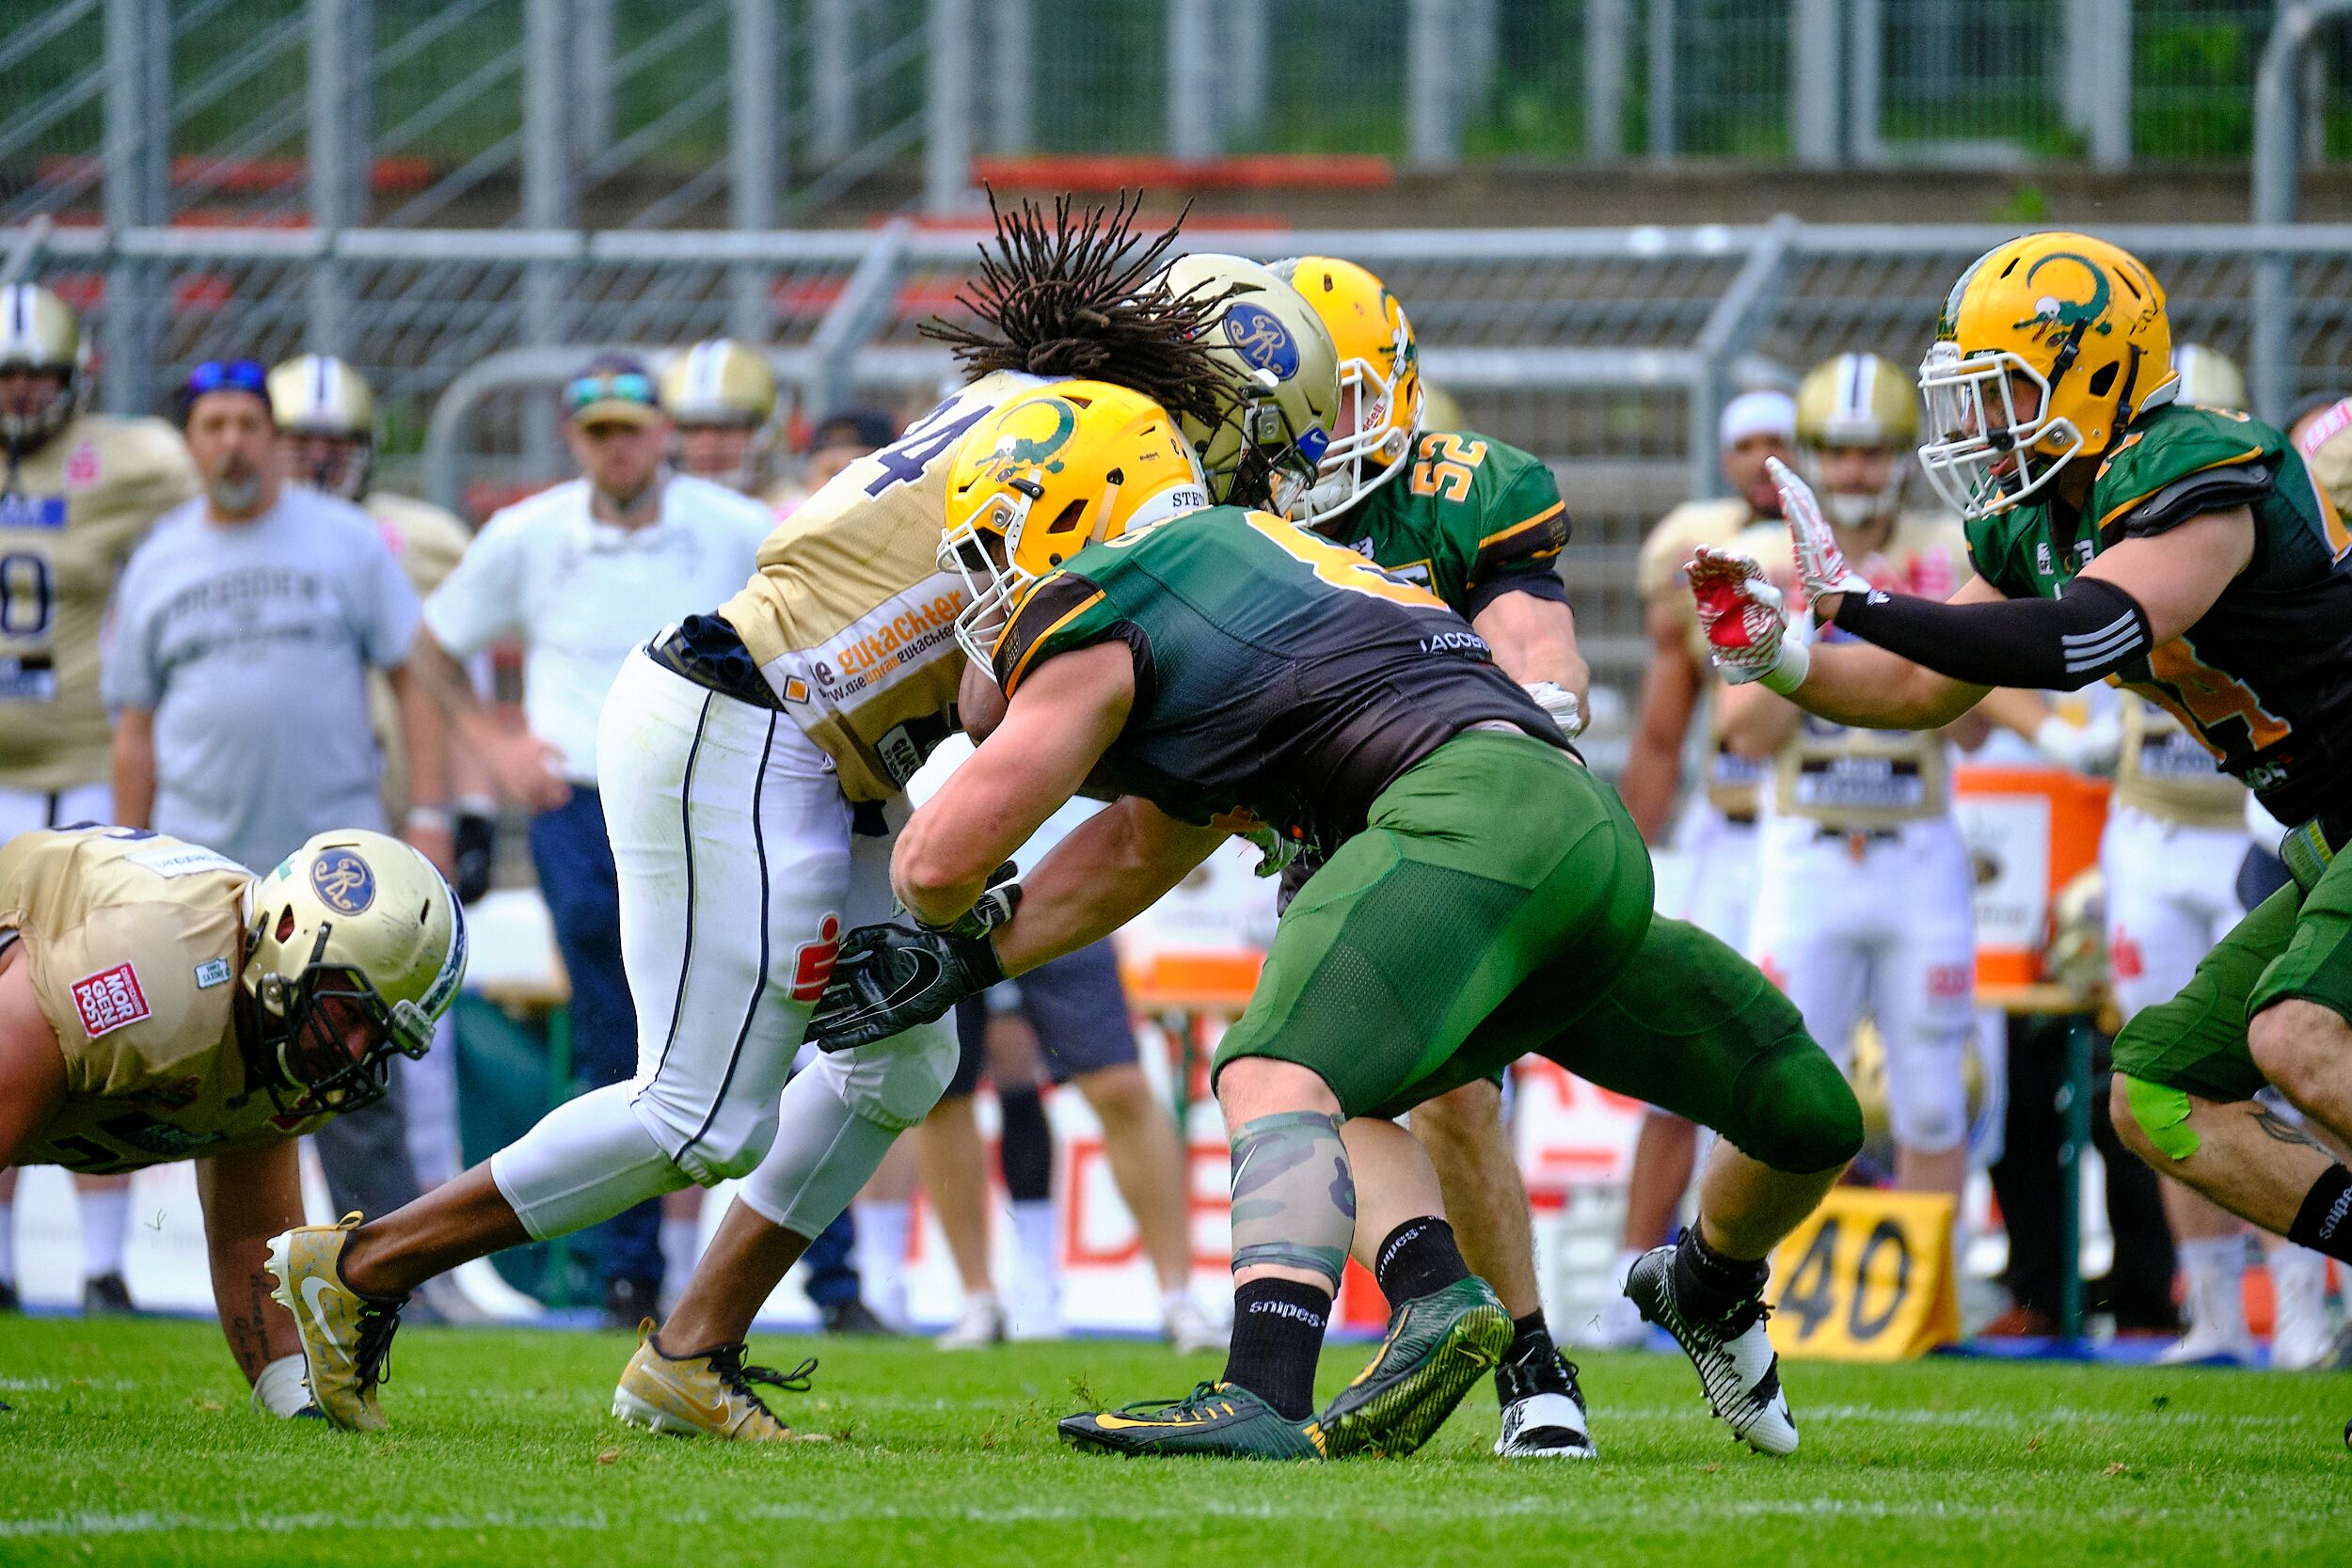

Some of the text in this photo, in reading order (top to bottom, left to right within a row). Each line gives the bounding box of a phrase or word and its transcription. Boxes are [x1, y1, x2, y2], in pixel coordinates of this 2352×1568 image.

[1410, 433, 1488, 503] 52
[836, 589, 964, 675] gutachter
[76, 984, 105, 1029] POST
[91, 979, 119, 1025] GEN
[103, 973, 135, 1022] MOR
[1777, 1217, 1911, 1341] 40
